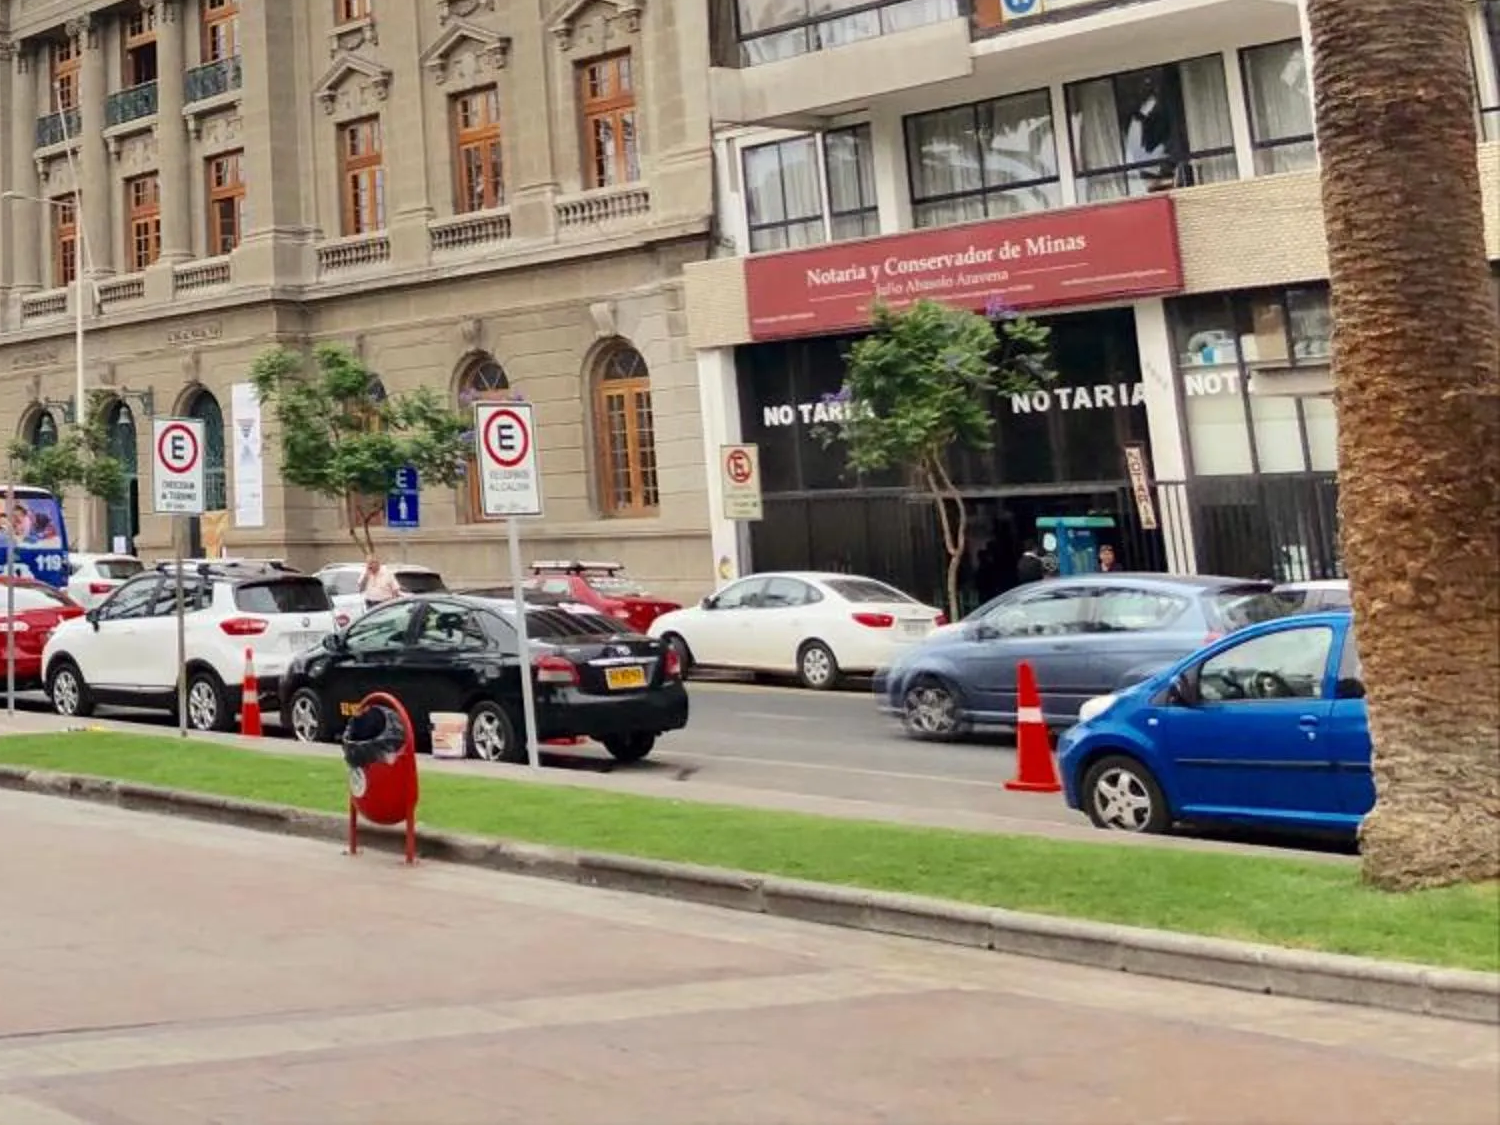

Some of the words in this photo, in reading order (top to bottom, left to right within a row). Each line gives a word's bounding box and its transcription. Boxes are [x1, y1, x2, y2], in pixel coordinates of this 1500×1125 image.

[806, 263, 866, 287] Notaria
[870, 265, 880, 283] y
[884, 244, 995, 276] Conservador
[999, 239, 1021, 261] de
[1025, 233, 1087, 257] Minas
[875, 281, 904, 300] Julio
[956, 269, 1008, 288] Aravena
[171, 435, 185, 460] E
[497, 424, 515, 450] E
[395, 469, 408, 488] E
